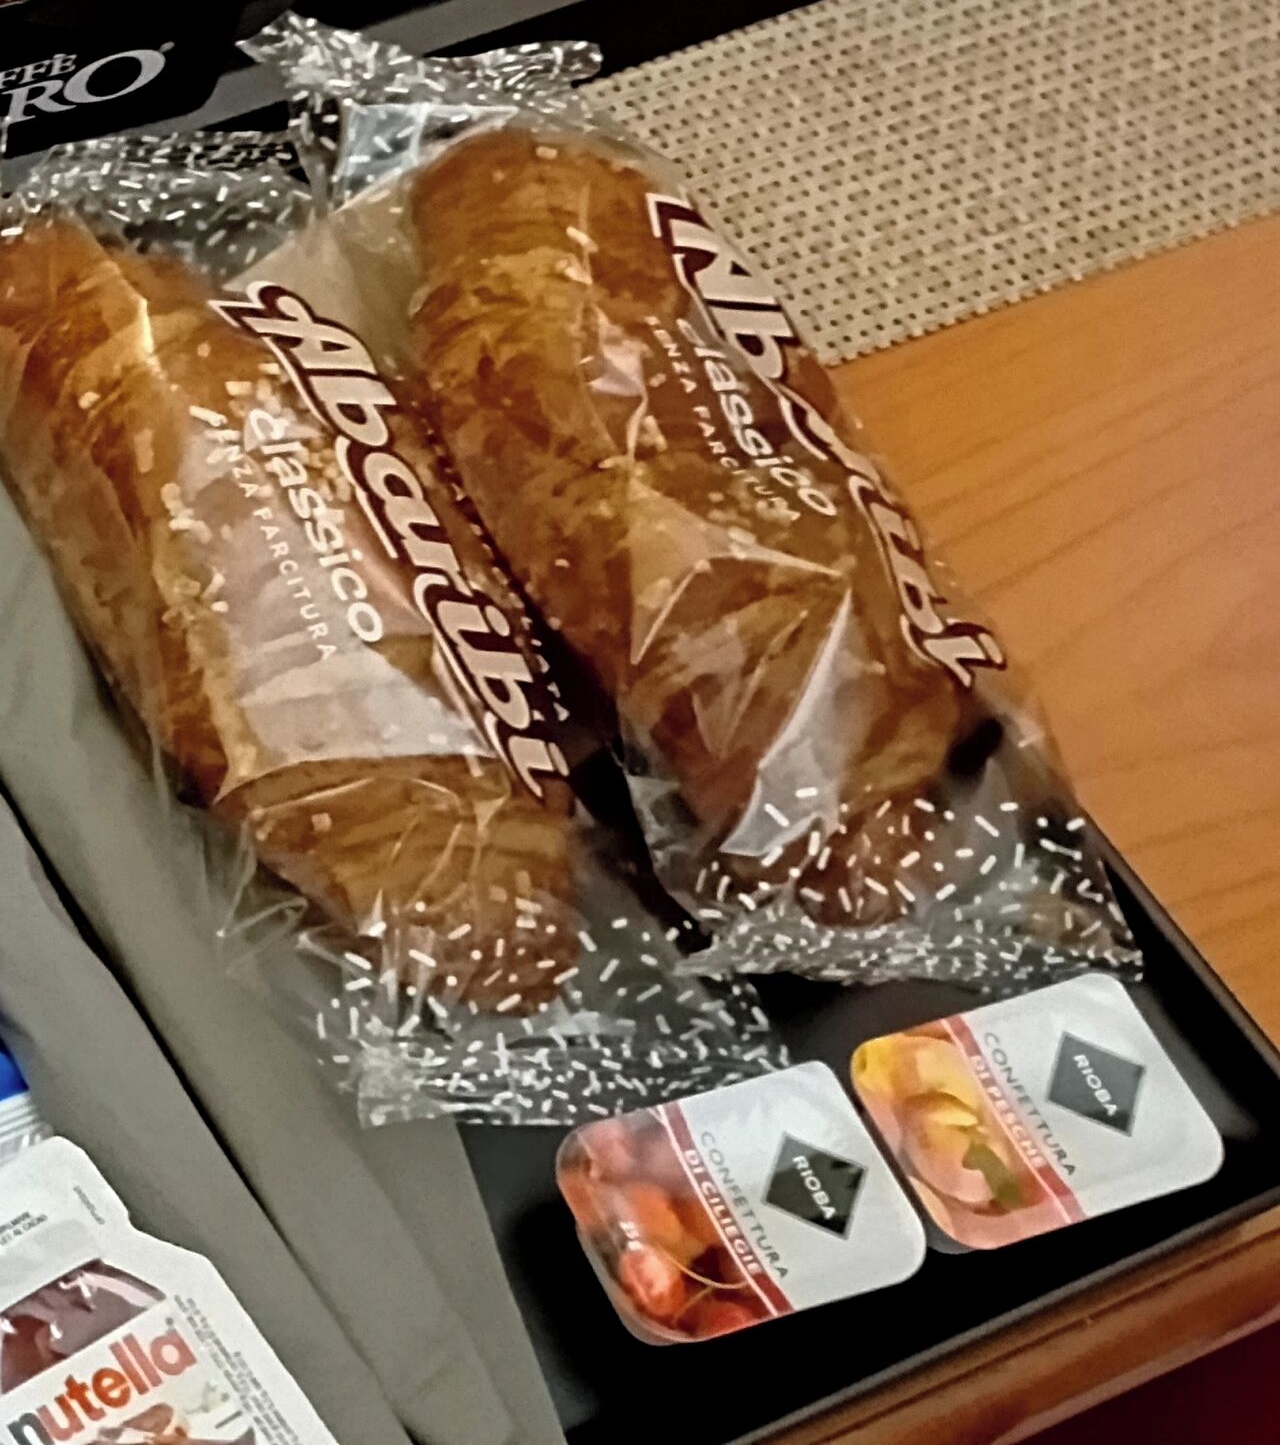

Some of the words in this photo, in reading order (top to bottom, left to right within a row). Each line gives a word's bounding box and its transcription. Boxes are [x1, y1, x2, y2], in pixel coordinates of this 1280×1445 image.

[212, 280, 569, 801] Abaribi
[248, 409, 383, 642] classico
[252, 506, 337, 661] FARCITURA
[970, 1053, 990, 1084] DI
[989, 1084, 1044, 1169] PESCHE
[983, 1031, 1076, 1177] CONFETTURA
[1073, 1053, 1119, 1119] RIOBA
[684, 1148, 701, 1177] DI
[698, 1179, 764, 1277] CILIEGIE
[700, 1130, 788, 1281] CONFETTURA
[792, 1154, 837, 1222] RIOBA
[7, 1329, 198, 1445] nutella
